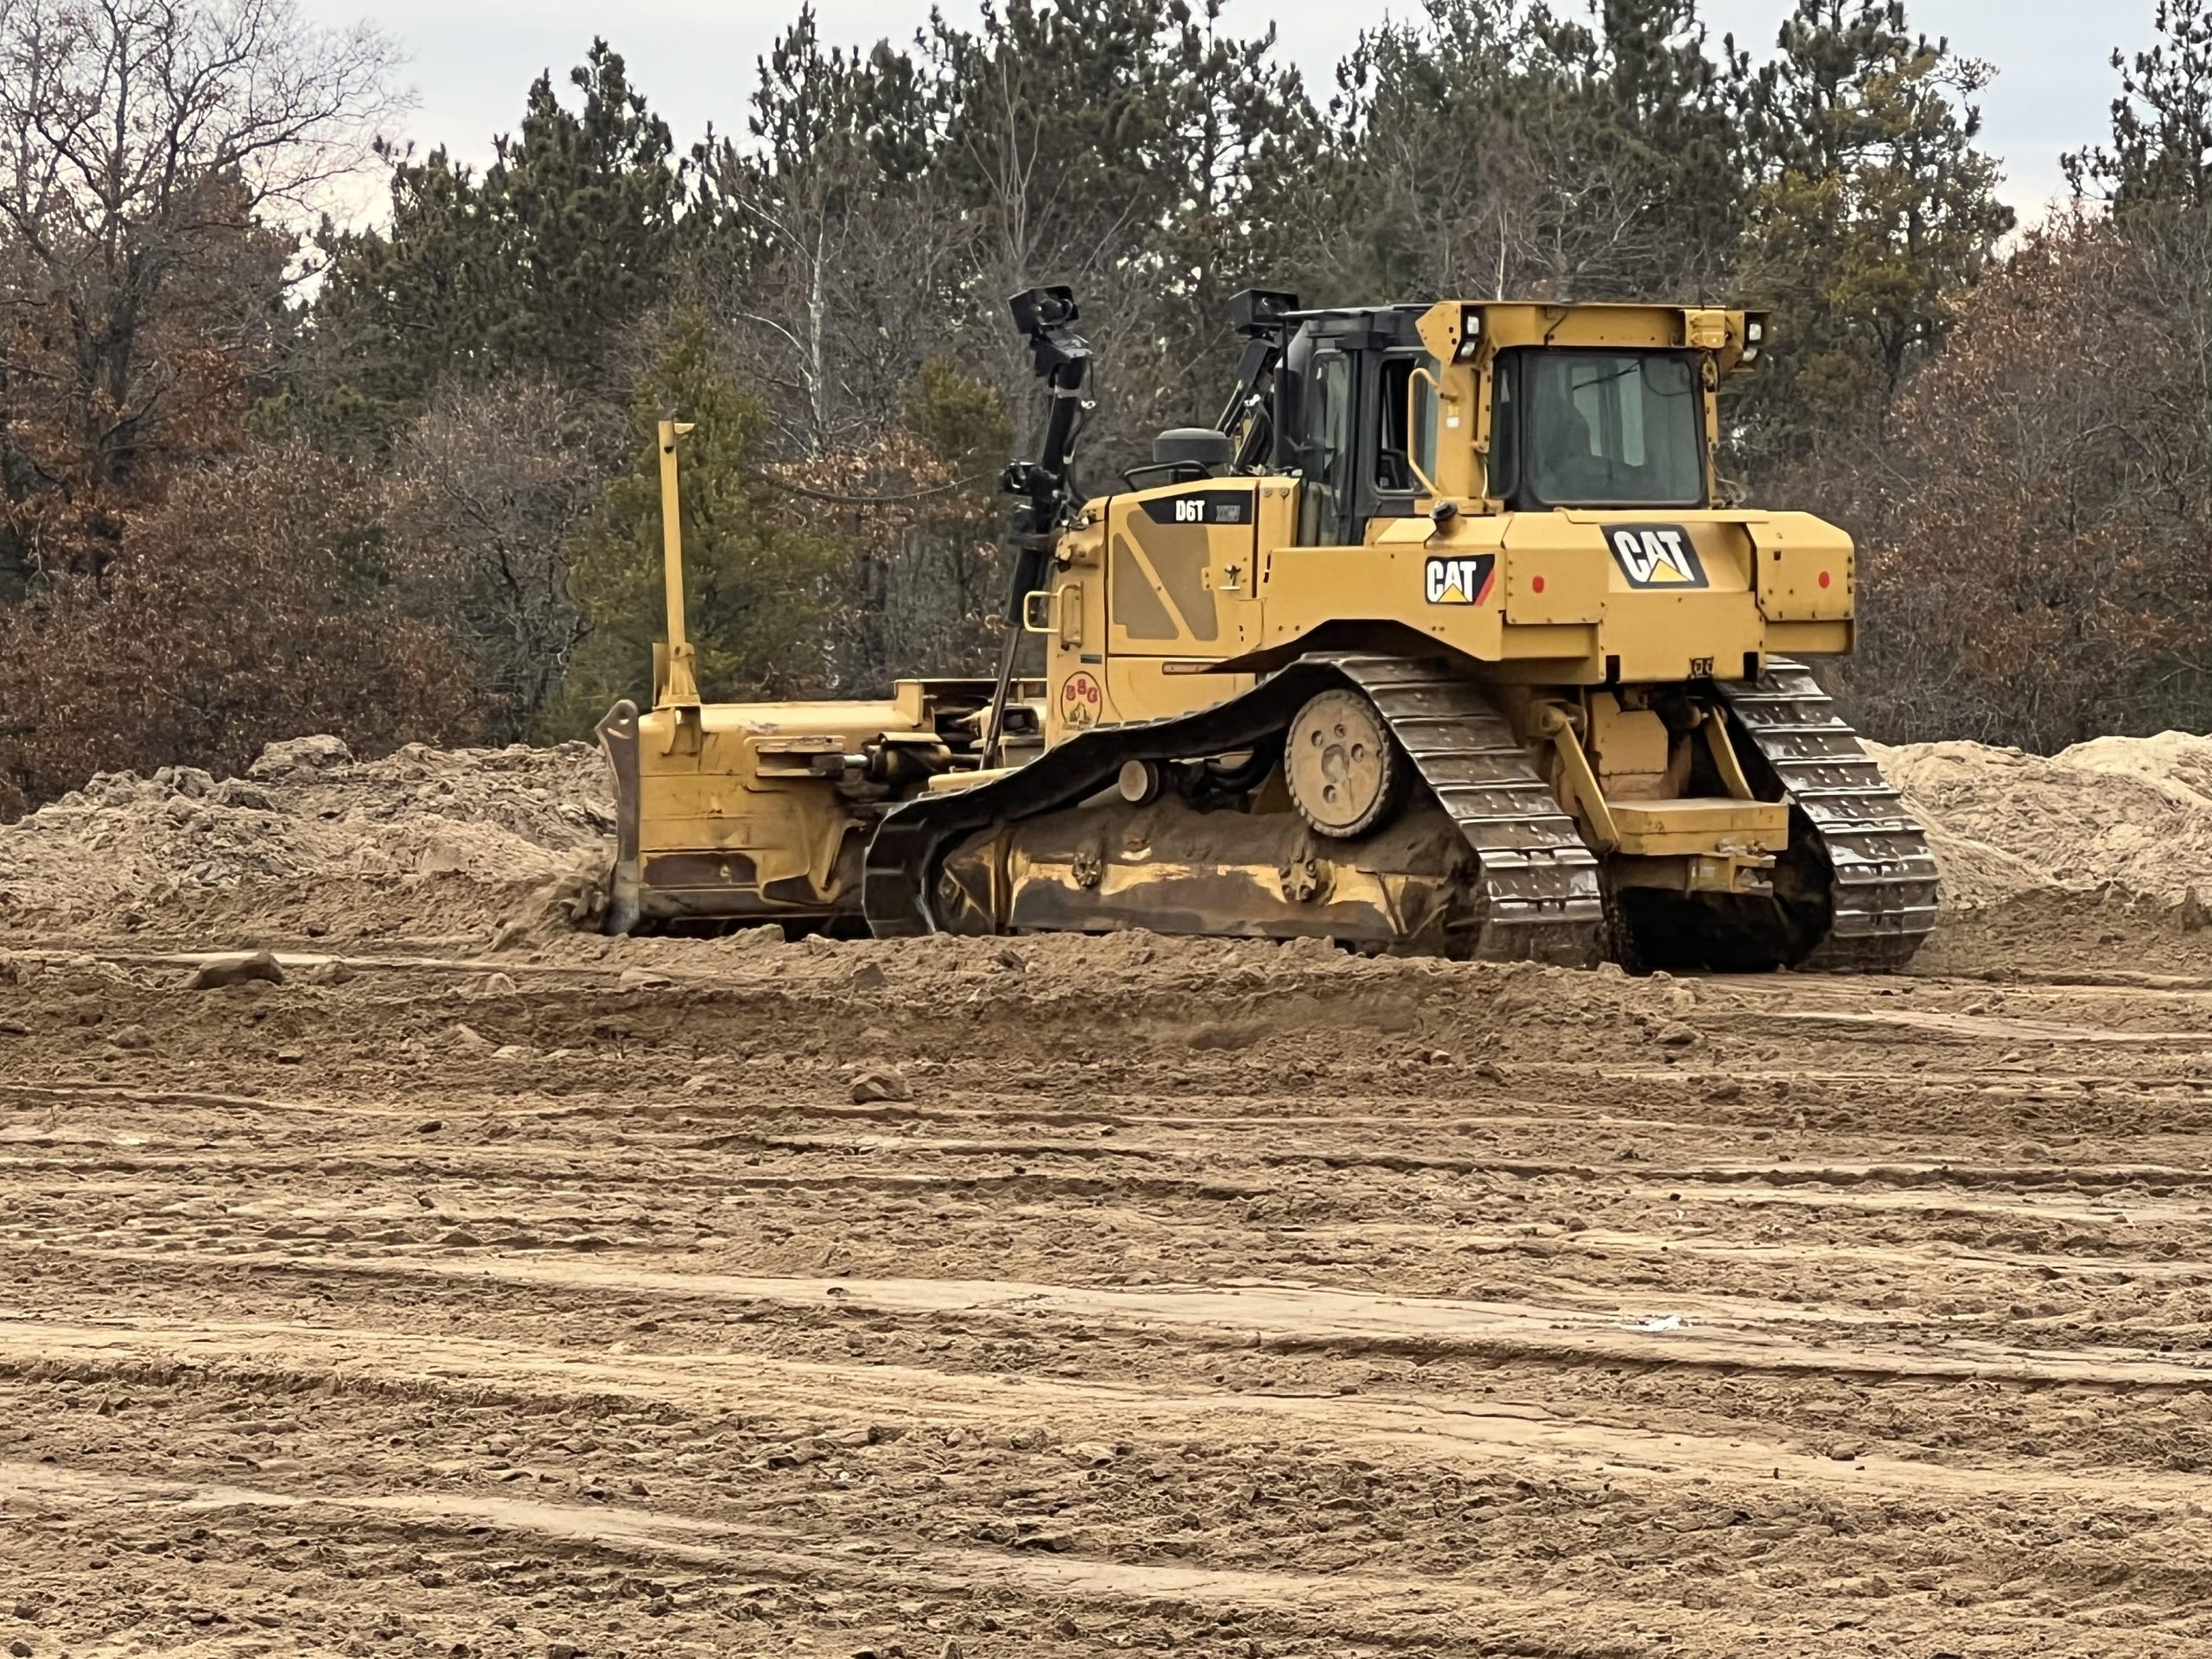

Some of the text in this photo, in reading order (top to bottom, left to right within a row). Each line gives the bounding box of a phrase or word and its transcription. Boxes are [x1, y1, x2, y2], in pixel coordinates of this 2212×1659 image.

[1175, 499, 1205, 522] D6T
[1613, 531, 1695, 582] CAT
[1427, 560, 1477, 603] CAT
